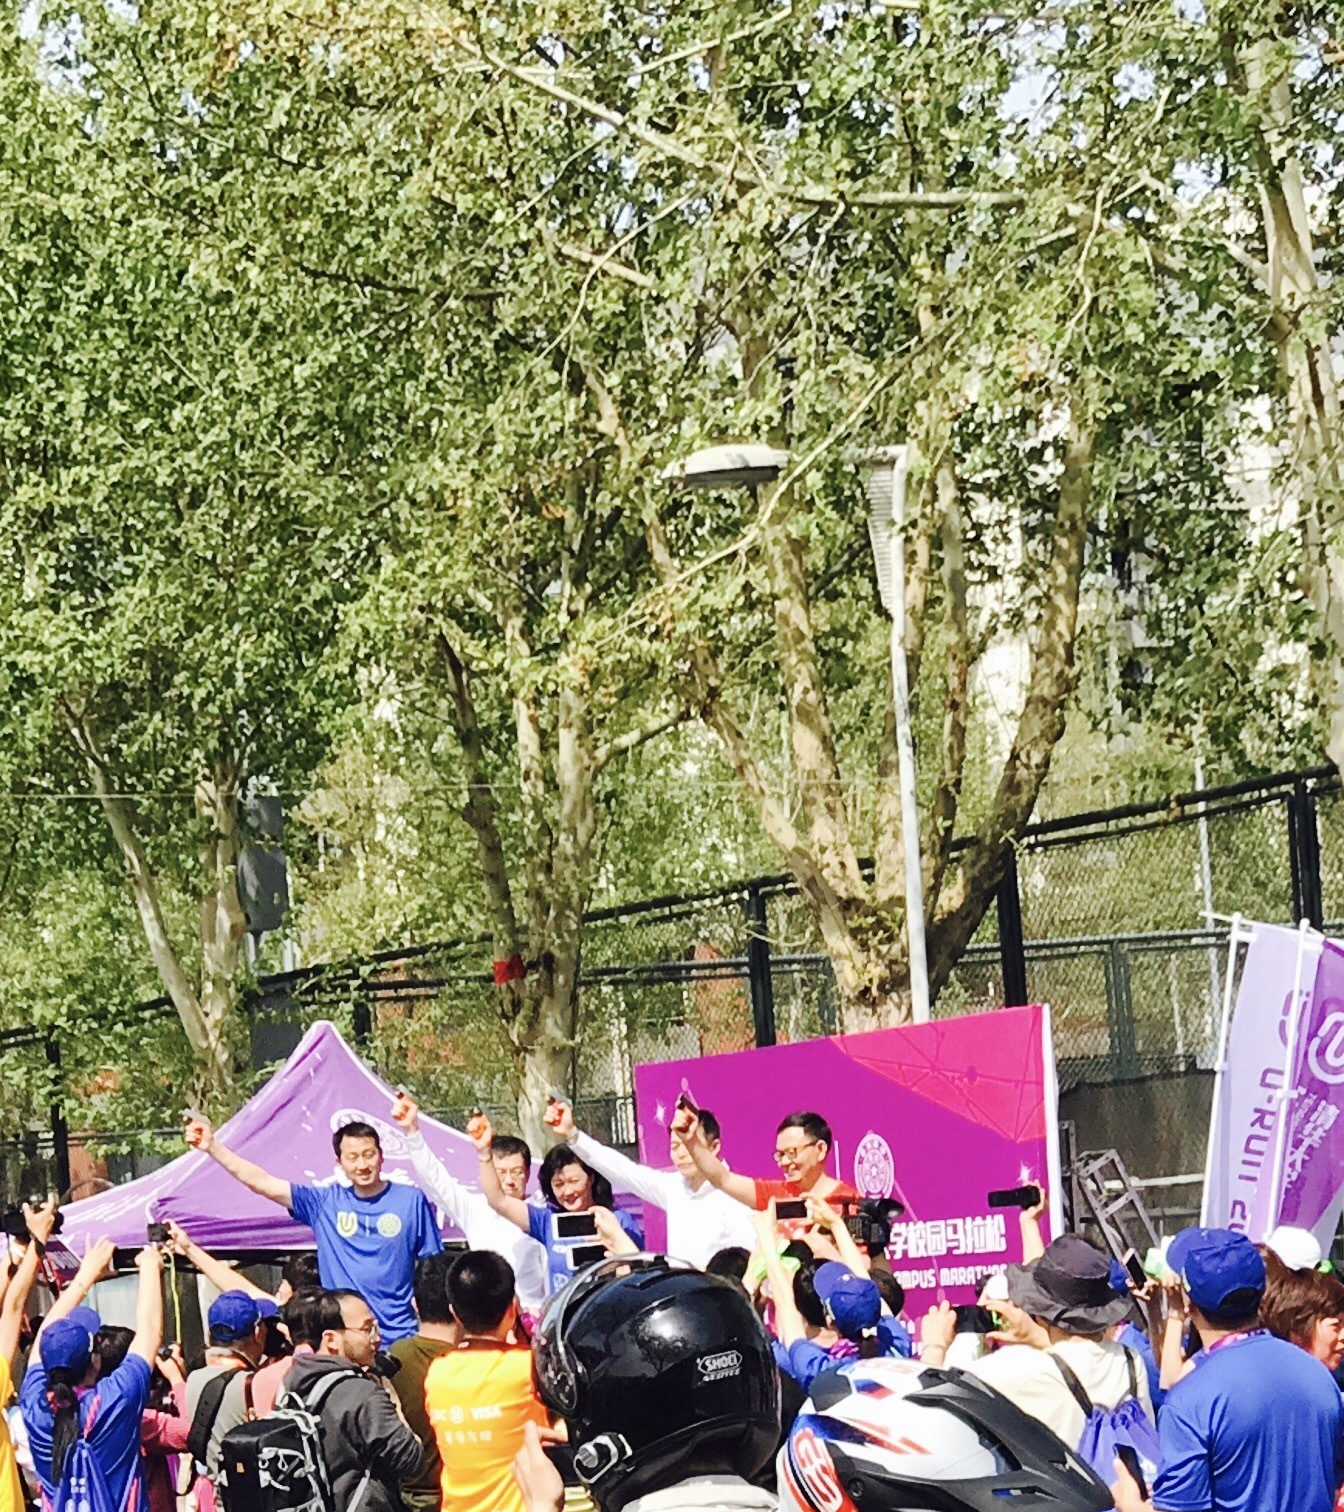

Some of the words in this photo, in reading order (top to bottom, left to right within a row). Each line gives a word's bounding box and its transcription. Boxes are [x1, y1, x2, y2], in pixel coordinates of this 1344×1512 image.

[883, 1213, 1007, 1261] 学校园马拉松
